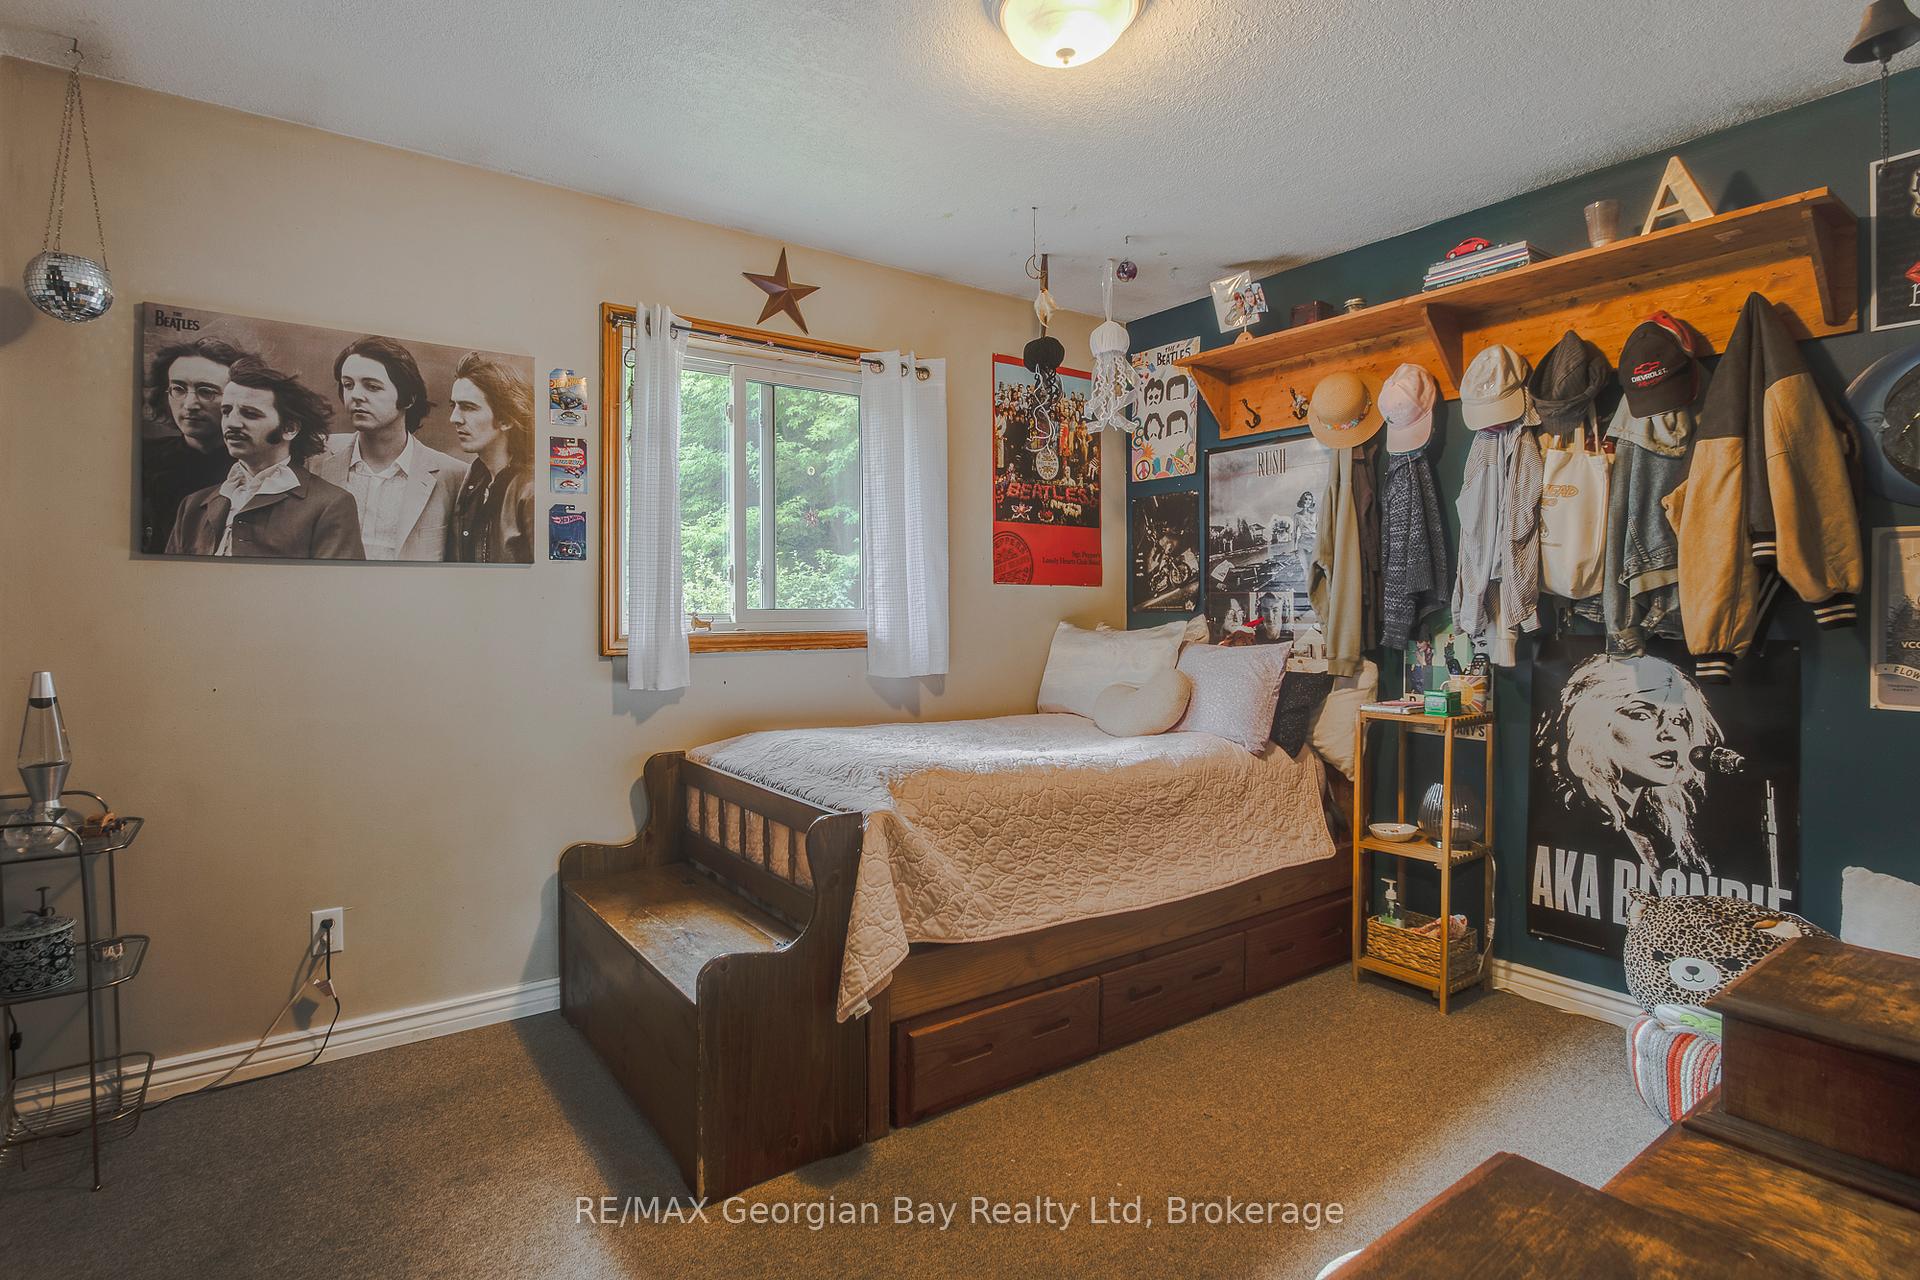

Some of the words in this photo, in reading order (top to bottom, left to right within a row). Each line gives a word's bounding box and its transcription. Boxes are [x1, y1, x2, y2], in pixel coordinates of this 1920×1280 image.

[1641, 155, 1715, 237] A
[155, 309, 200, 331] BEATLES
[1258, 448, 1286, 477] RUSH
[1006, 481, 1090, 506] BEATLES
[1532, 845, 1601, 920] AKA
